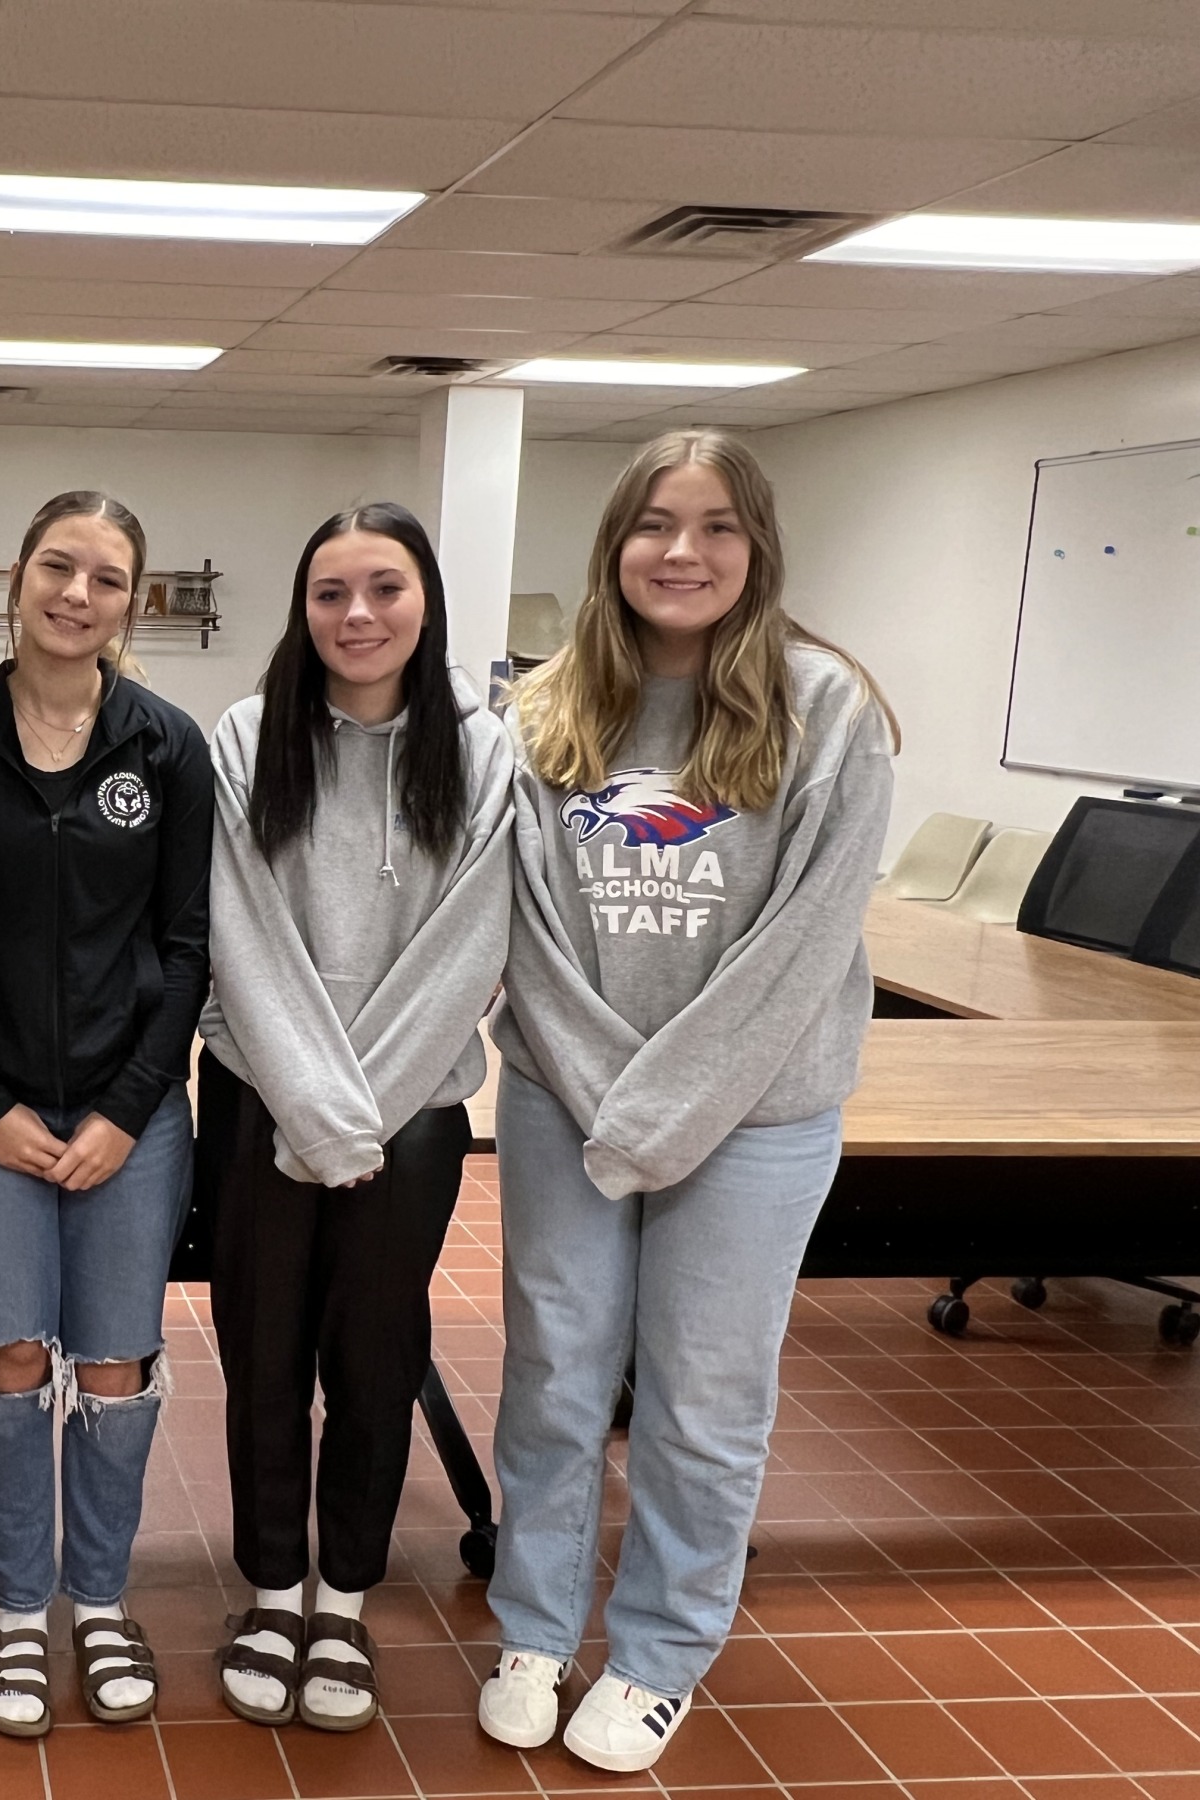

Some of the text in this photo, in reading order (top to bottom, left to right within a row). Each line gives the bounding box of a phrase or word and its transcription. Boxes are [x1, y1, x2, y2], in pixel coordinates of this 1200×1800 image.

[113, 772, 144, 788] COUNTY
[142, 790, 151, 809] TEEN
[129, 809, 149, 828] COURT
[576, 843, 725, 888] ALMA
[592, 880, 691, 904] SCHOOL
